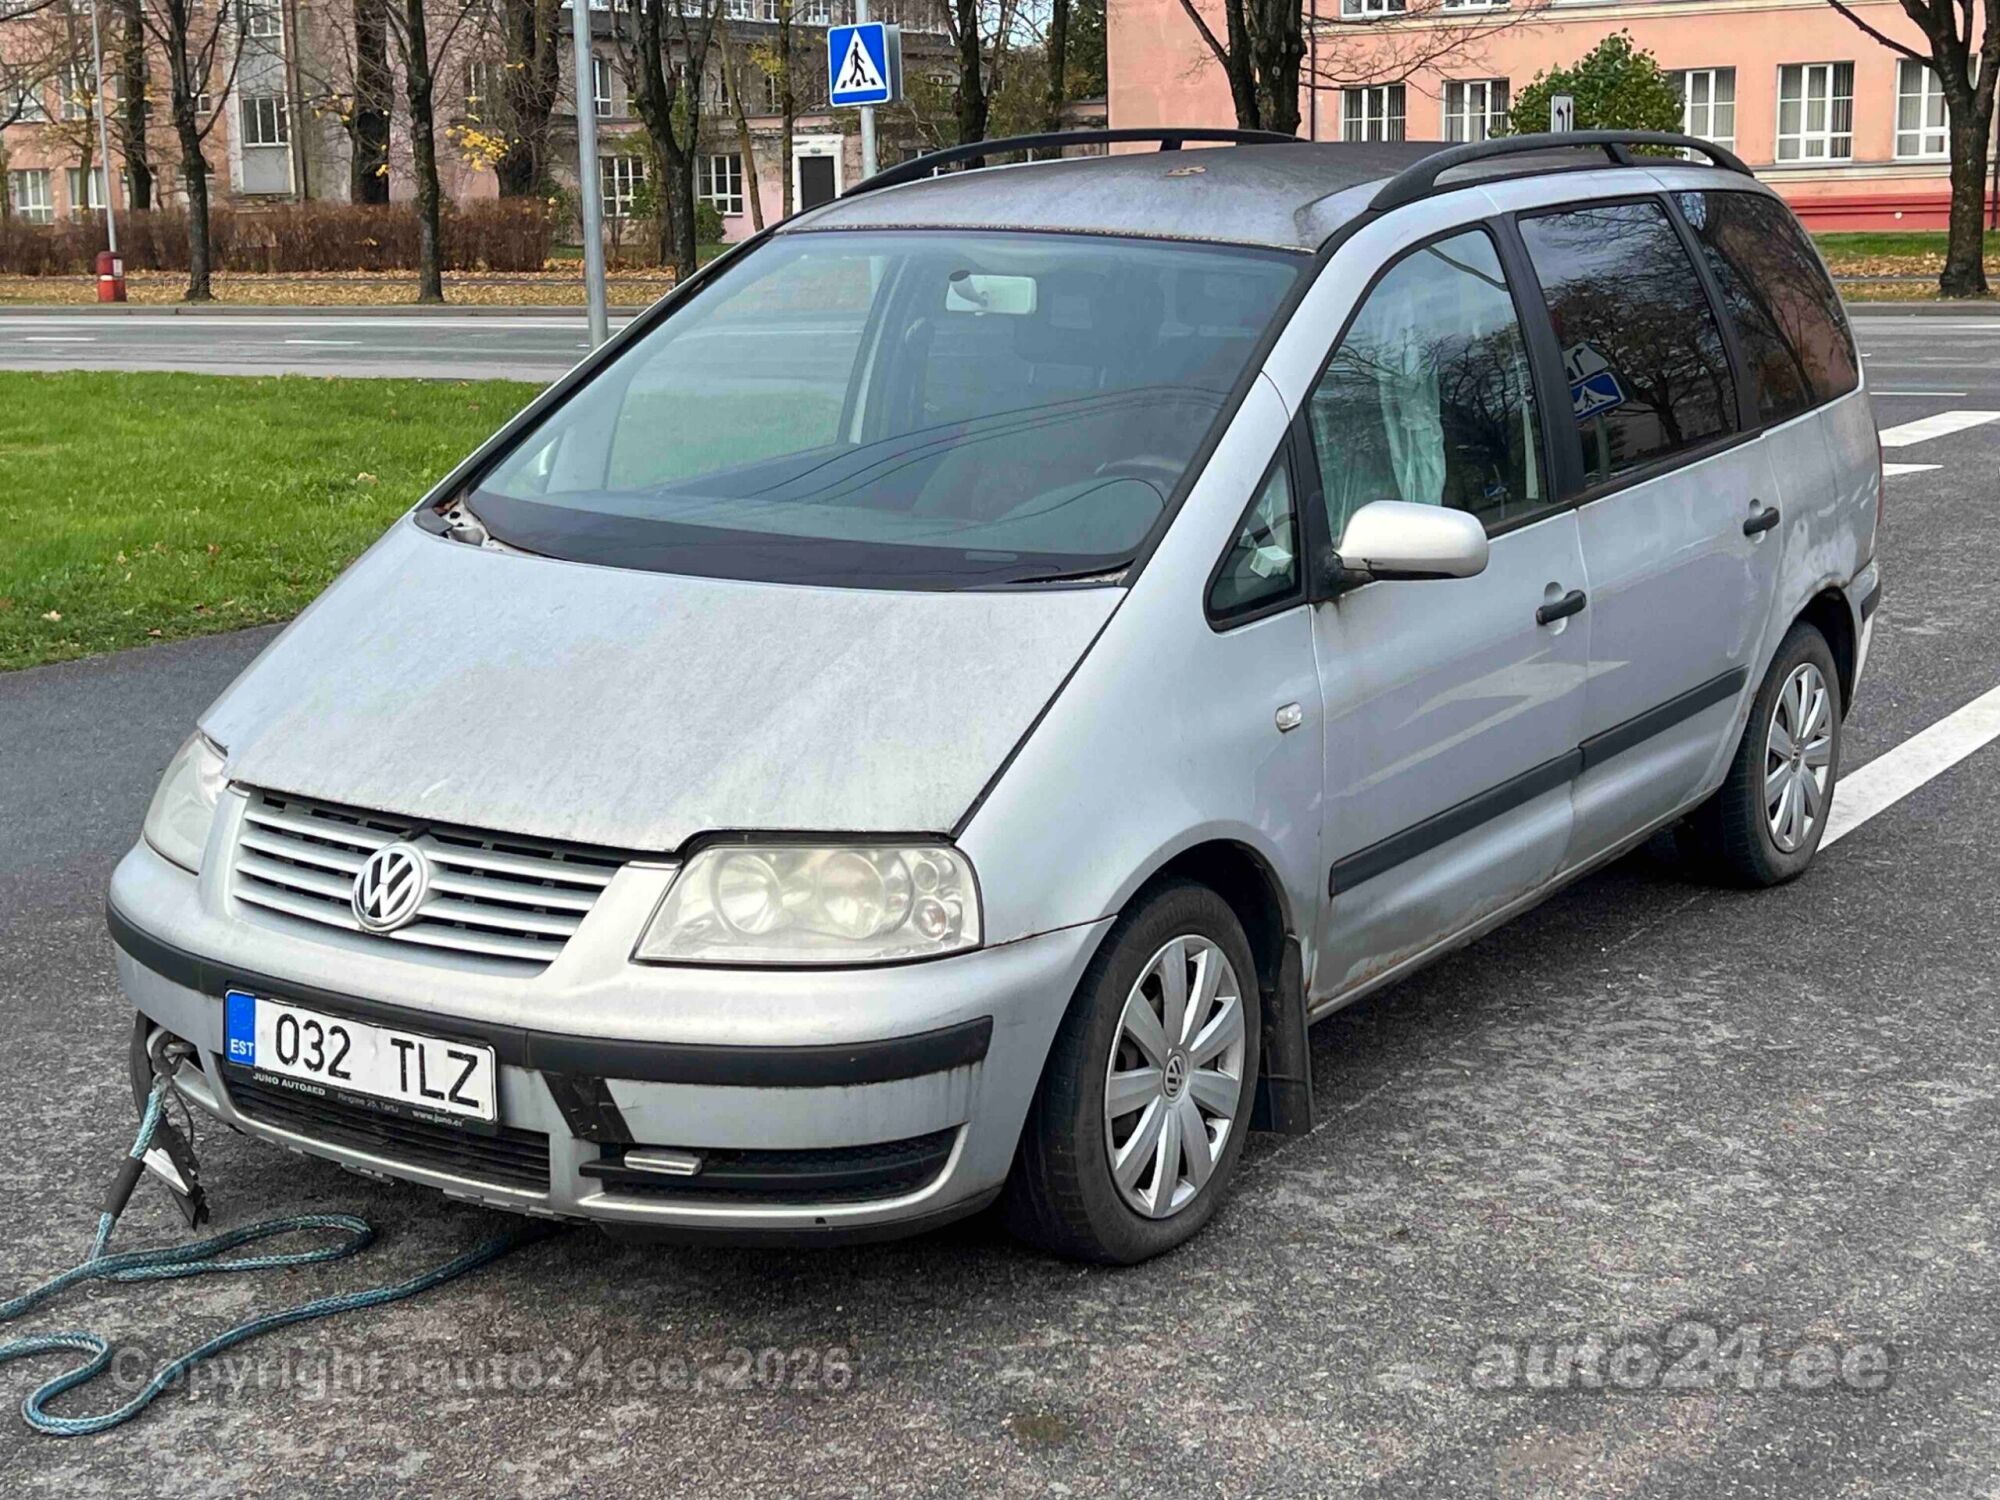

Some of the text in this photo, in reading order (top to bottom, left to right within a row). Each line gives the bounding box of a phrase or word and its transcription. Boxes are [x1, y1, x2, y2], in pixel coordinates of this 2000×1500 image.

[230, 1039, 255, 1057] EST
[276, 1013, 479, 1108] 032 TLZ
[253, 1072, 279, 1085] JUNO
